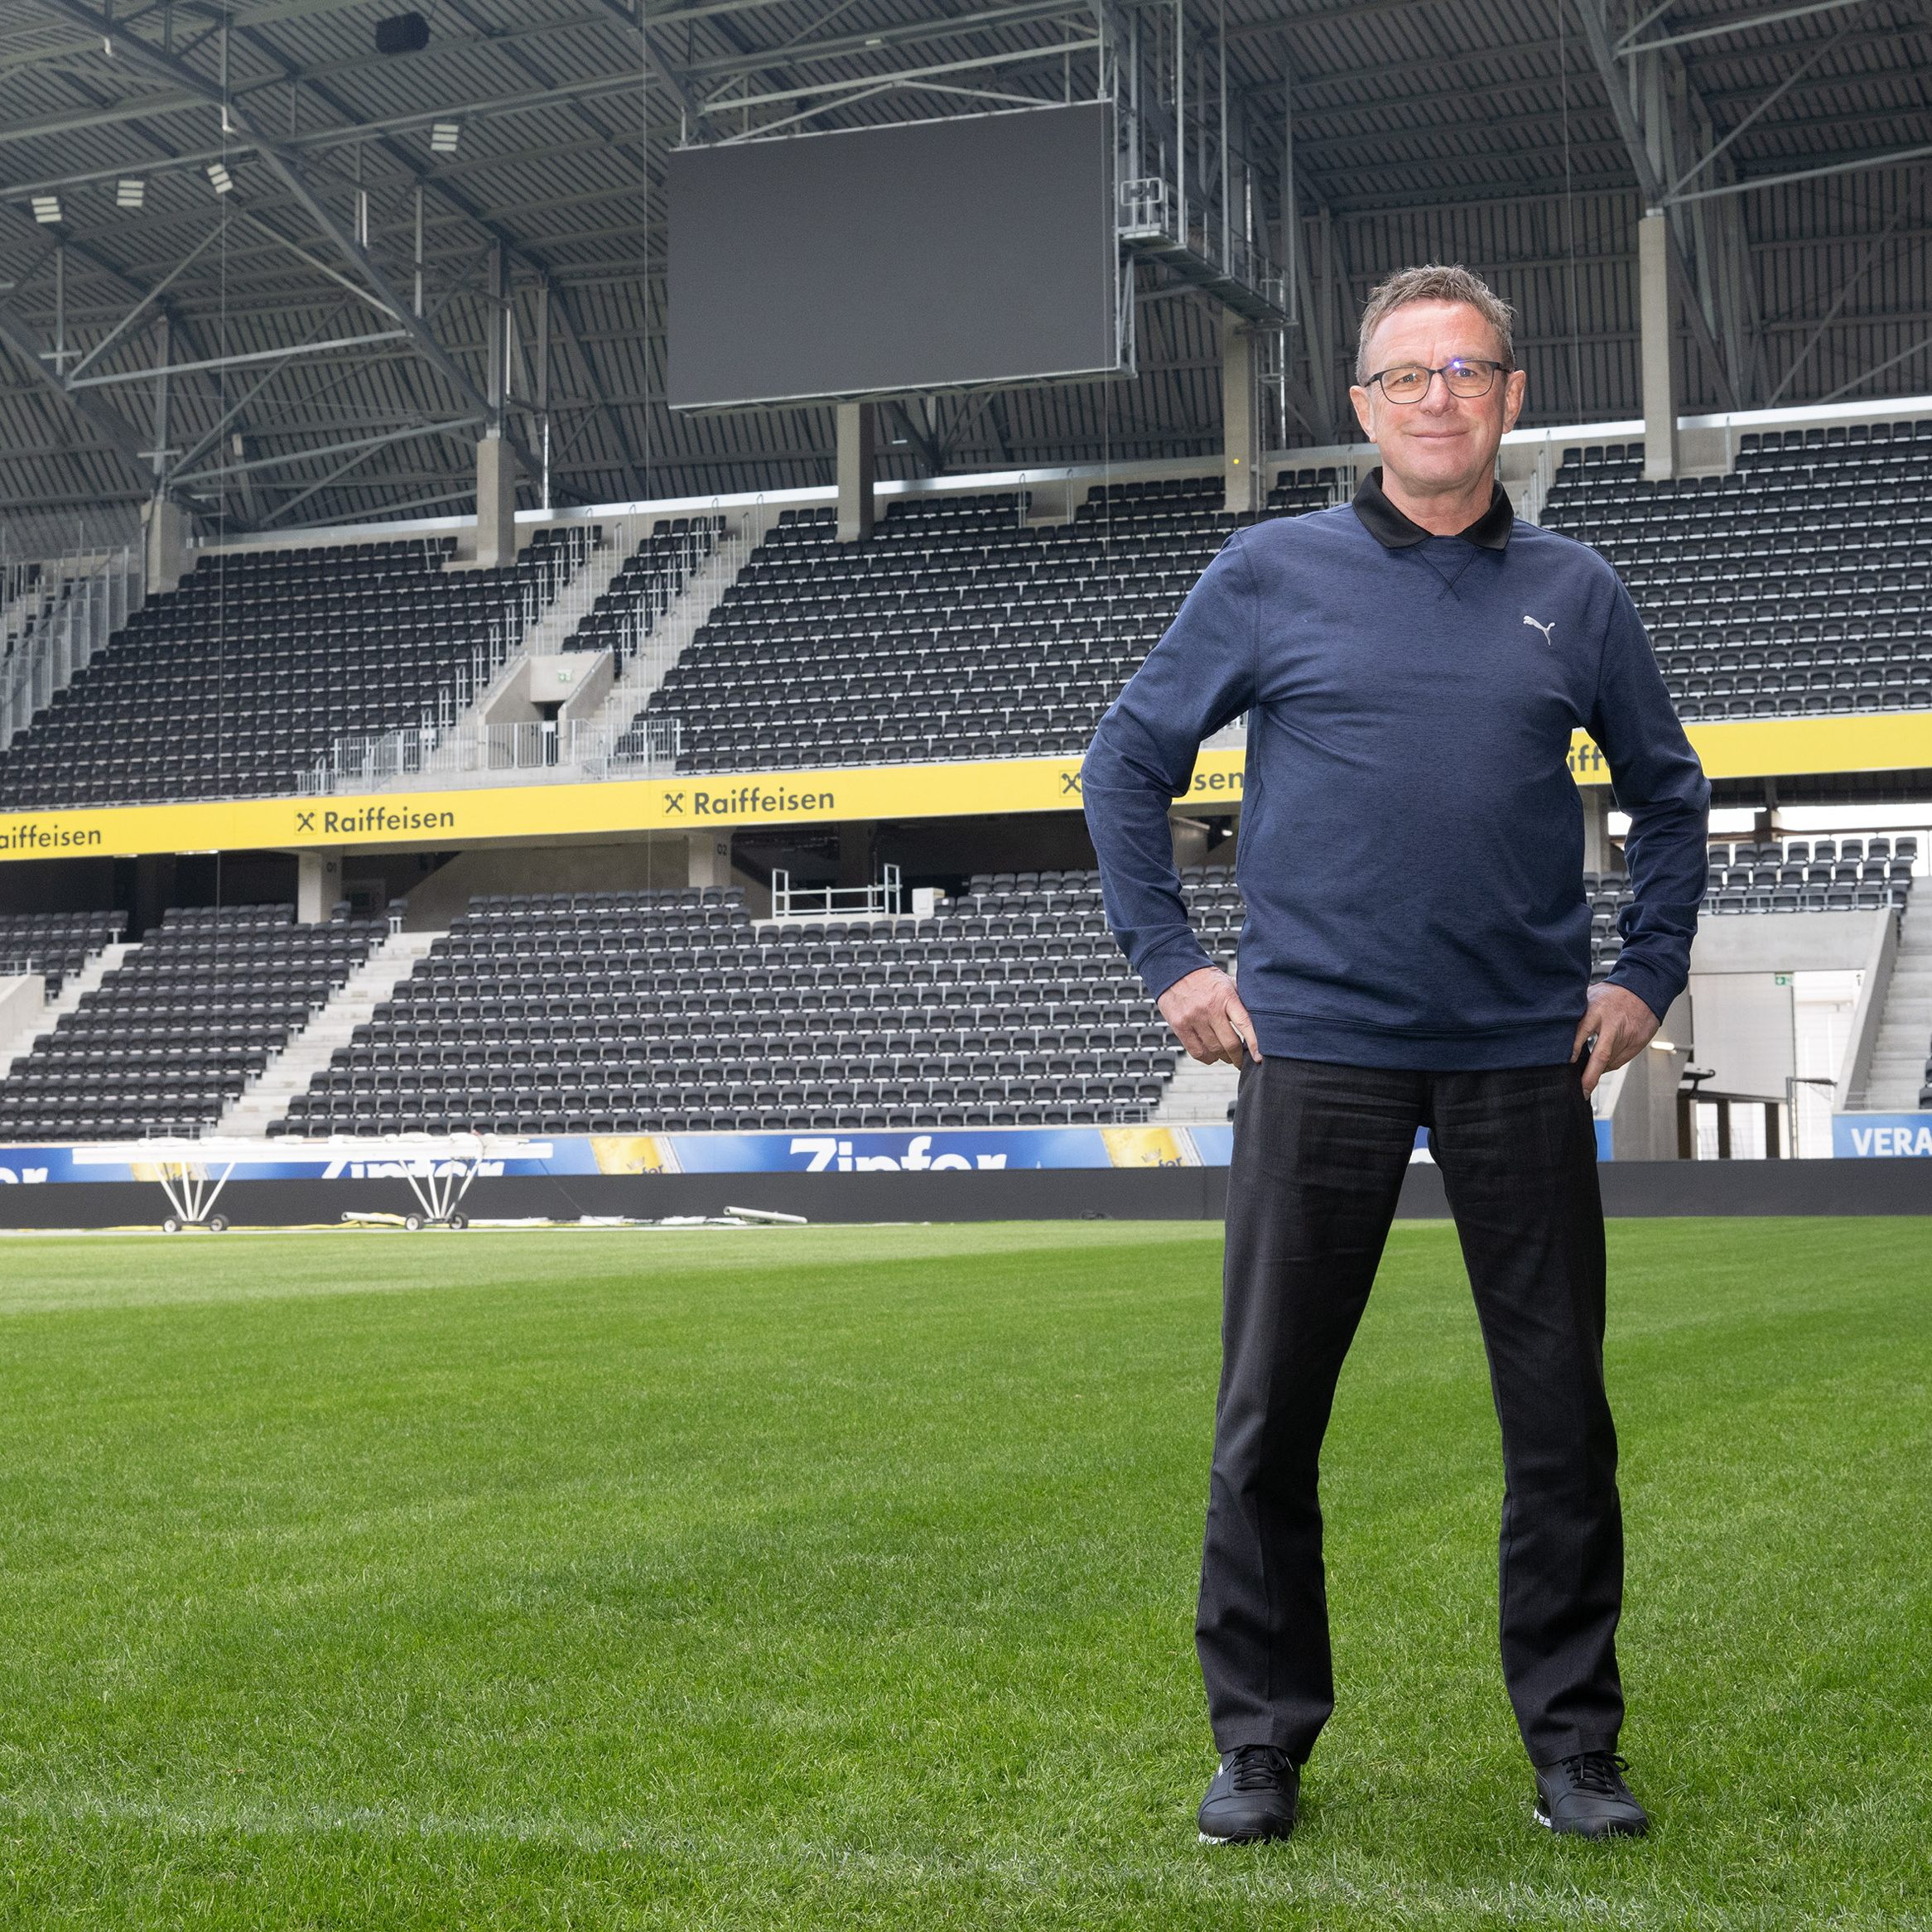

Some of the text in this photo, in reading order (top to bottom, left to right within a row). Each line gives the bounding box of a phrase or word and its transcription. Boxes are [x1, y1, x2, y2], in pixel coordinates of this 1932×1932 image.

[694, 787, 835, 815] Raiffeisen
[325, 806, 455, 833] Raiffeisen
[1850, 1126, 1932, 1157] VERA
